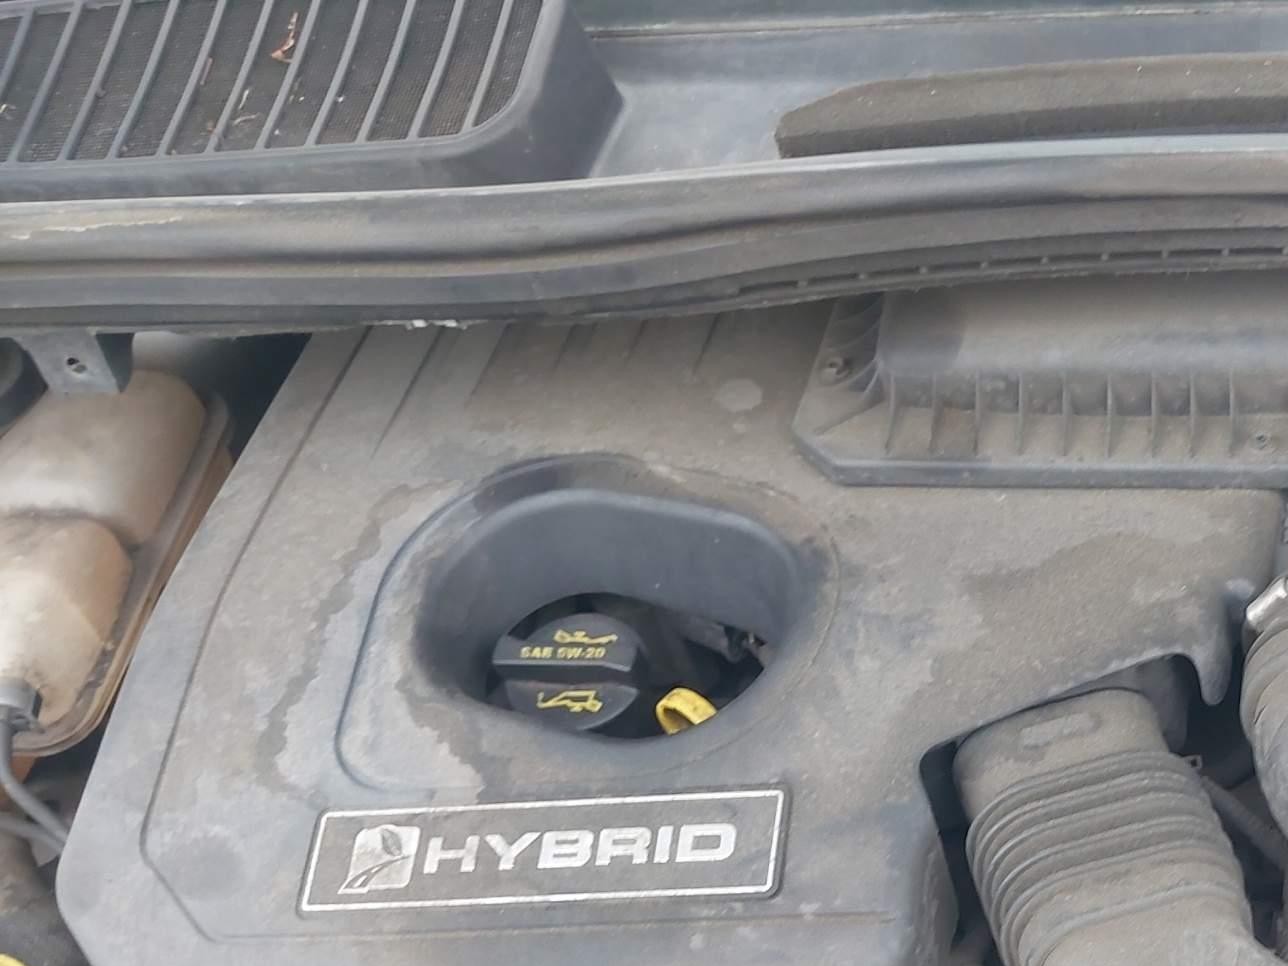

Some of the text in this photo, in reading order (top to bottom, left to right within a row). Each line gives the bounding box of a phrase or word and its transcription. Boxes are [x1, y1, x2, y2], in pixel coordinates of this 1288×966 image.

[521, 646, 607, 660] SAE 5W-20
[422, 823, 738, 875] HYBRID
